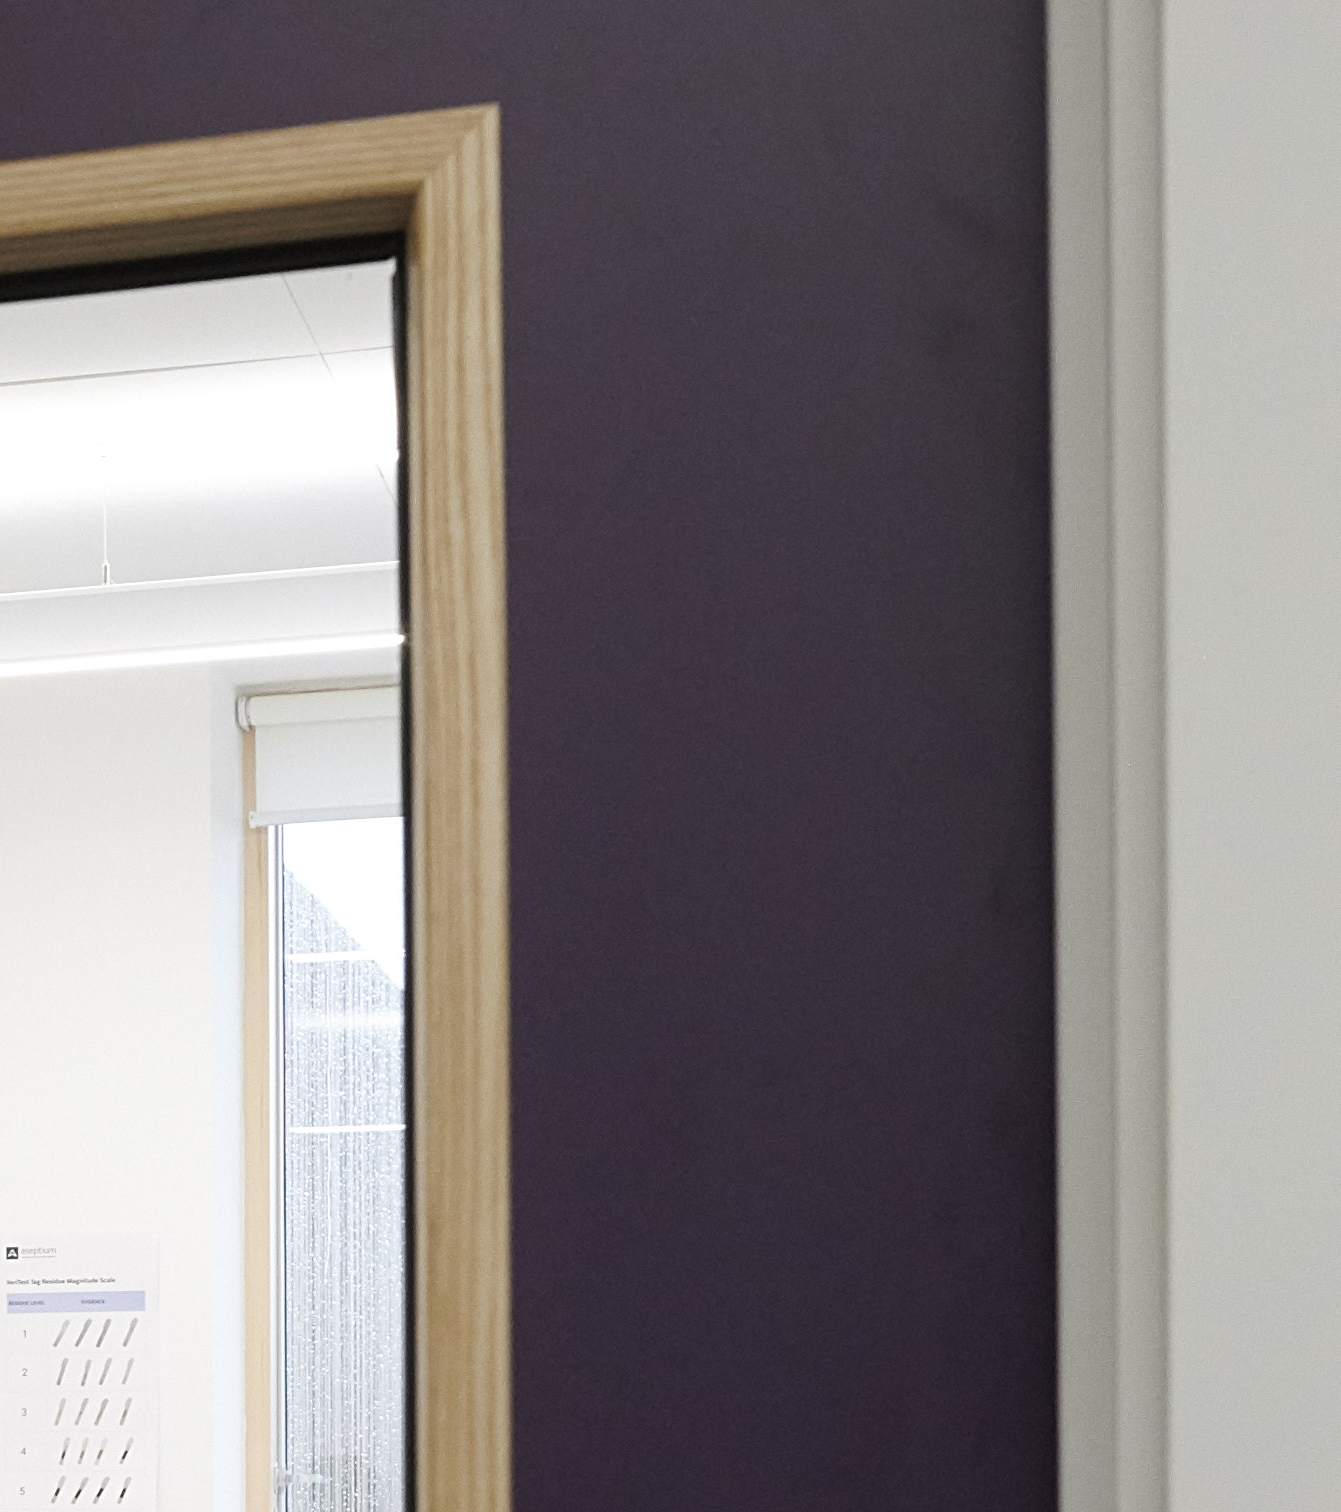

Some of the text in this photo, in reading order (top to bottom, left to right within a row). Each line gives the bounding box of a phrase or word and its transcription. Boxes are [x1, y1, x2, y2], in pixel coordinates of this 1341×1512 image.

[22, 1329, 28, 1339] 1
[21, 1368, 28, 1377] 2
[21, 1408, 28, 1417] 3
[20, 1447, 27, 1456] 4
[19, 1487, 26, 1496] 5
